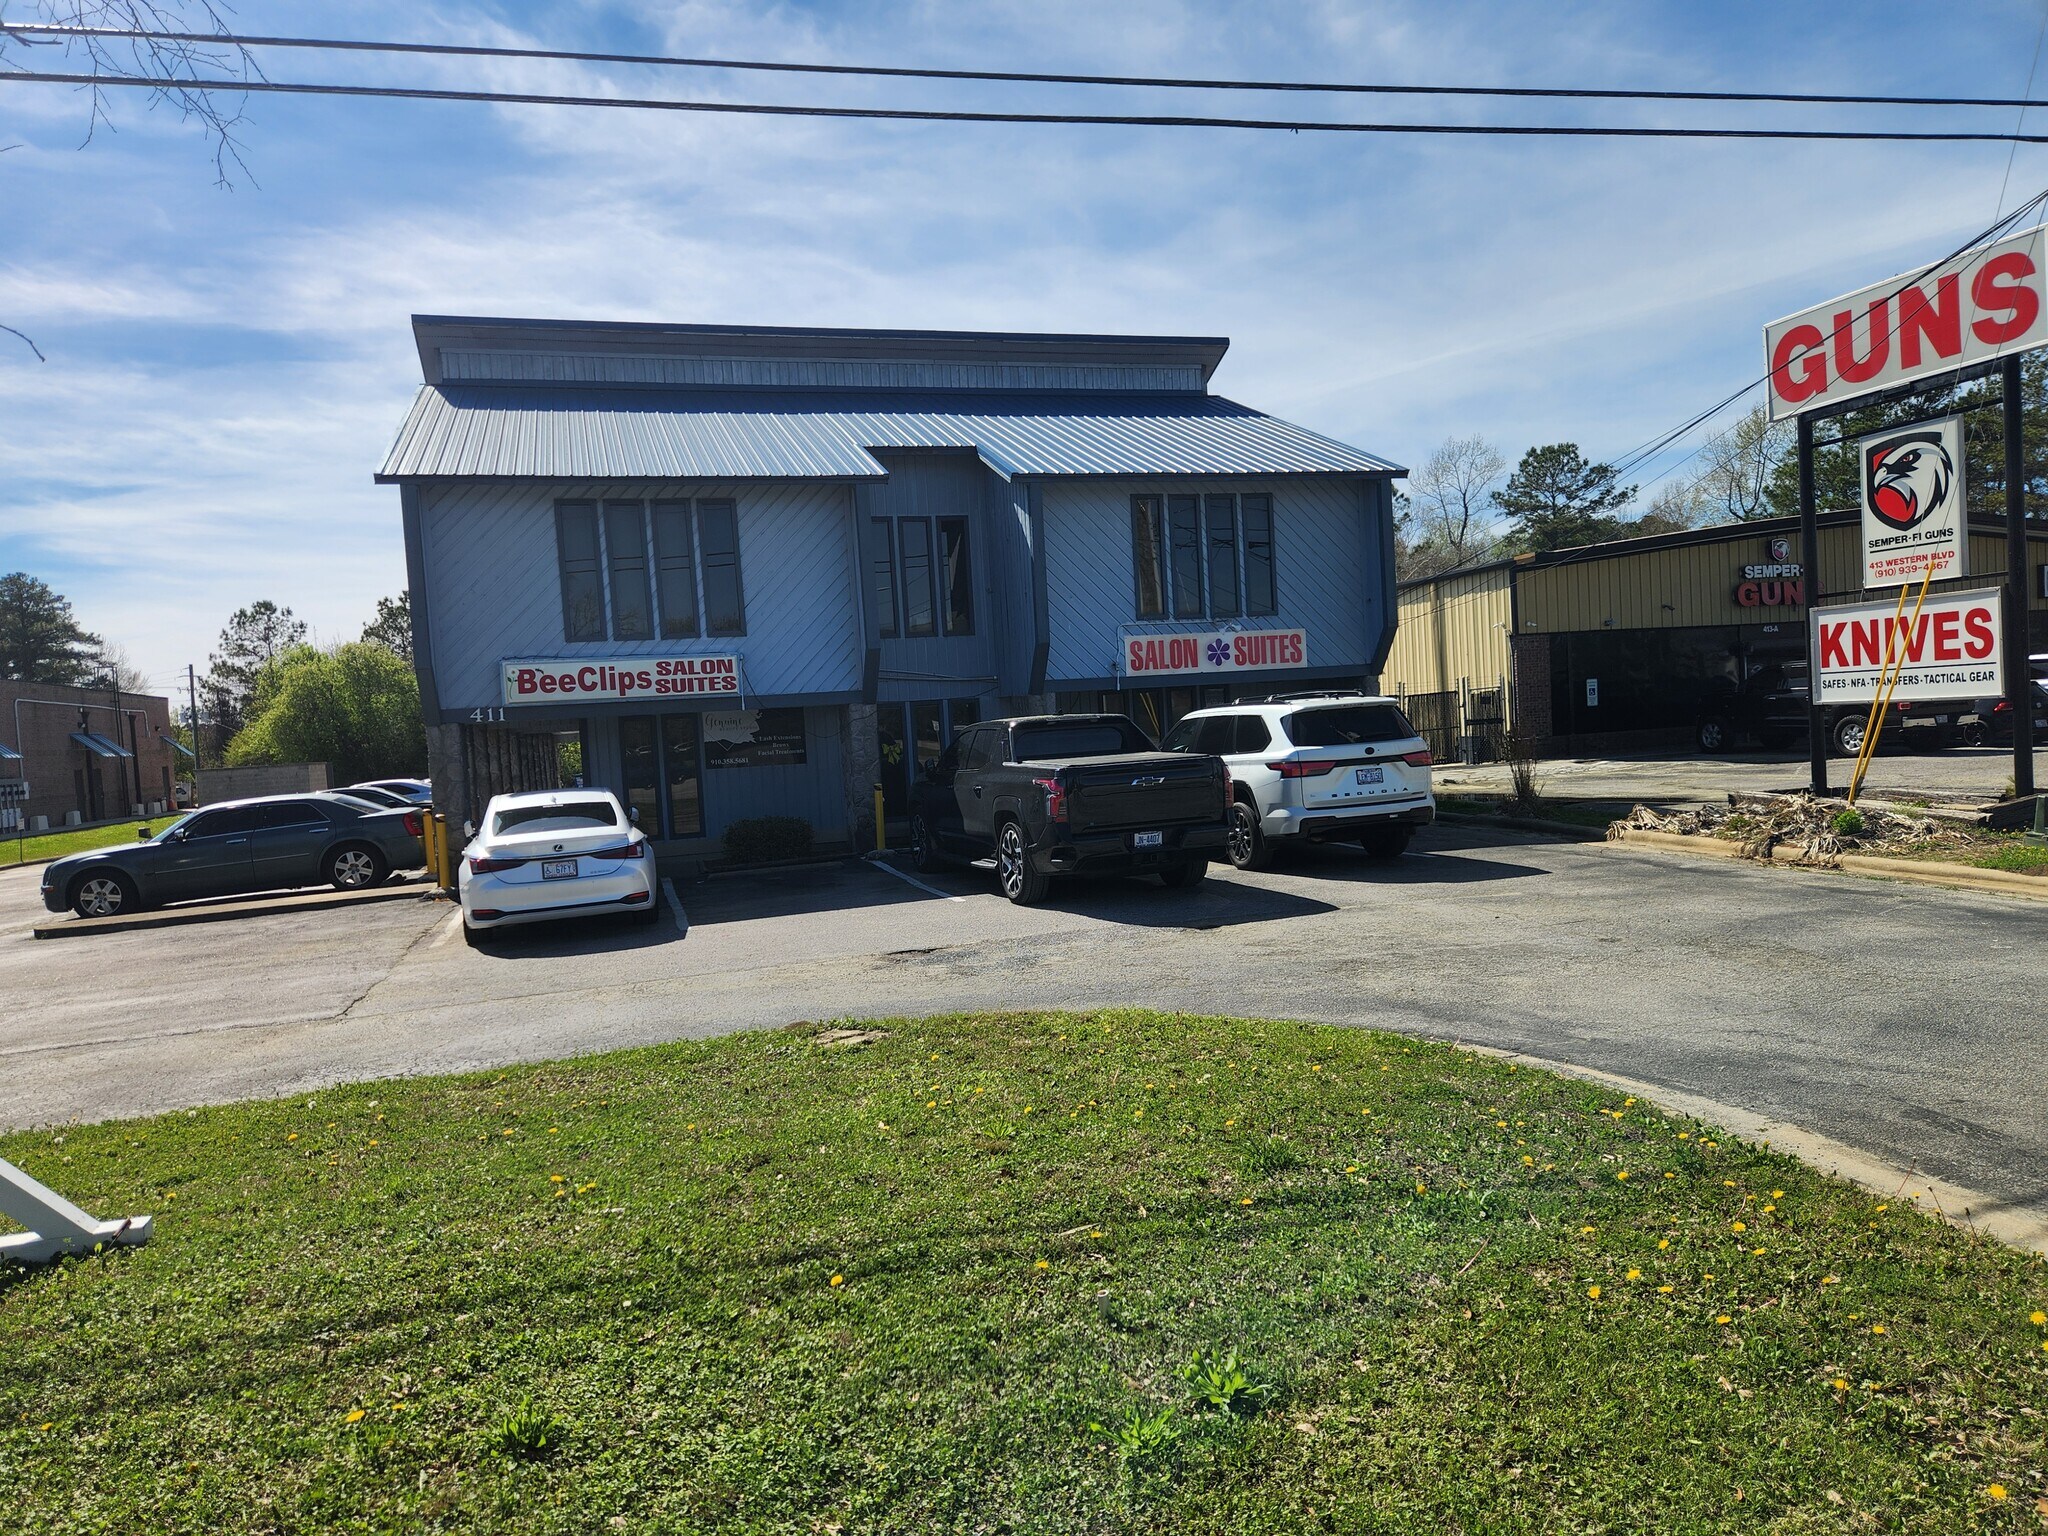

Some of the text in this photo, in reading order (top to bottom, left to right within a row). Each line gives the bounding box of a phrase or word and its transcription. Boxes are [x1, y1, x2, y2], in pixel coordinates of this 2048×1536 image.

[1772, 252, 2039, 403] GUNS
[1868, 528, 1954, 548] SEMPER-FI GUNS
[1869, 550, 1955, 570] 413 WESTERN BLVD
[1874, 568, 1897, 579] (910)
[1820, 607, 1995, 669] KNIVES
[1130, 633, 1303, 671] SALON SUITES
[655, 659, 734, 676] SALON
[517, 665, 653, 697] BeeClips
[655, 675, 737, 694] SUITES
[1822, 679, 1847, 689] SAFES
[1851, 677, 1867, 688] NFA
[1924, 672, 1967, 684] TACTICAL
[1969, 670, 1995, 681] GEAR
[470, 707, 506, 722] 411
